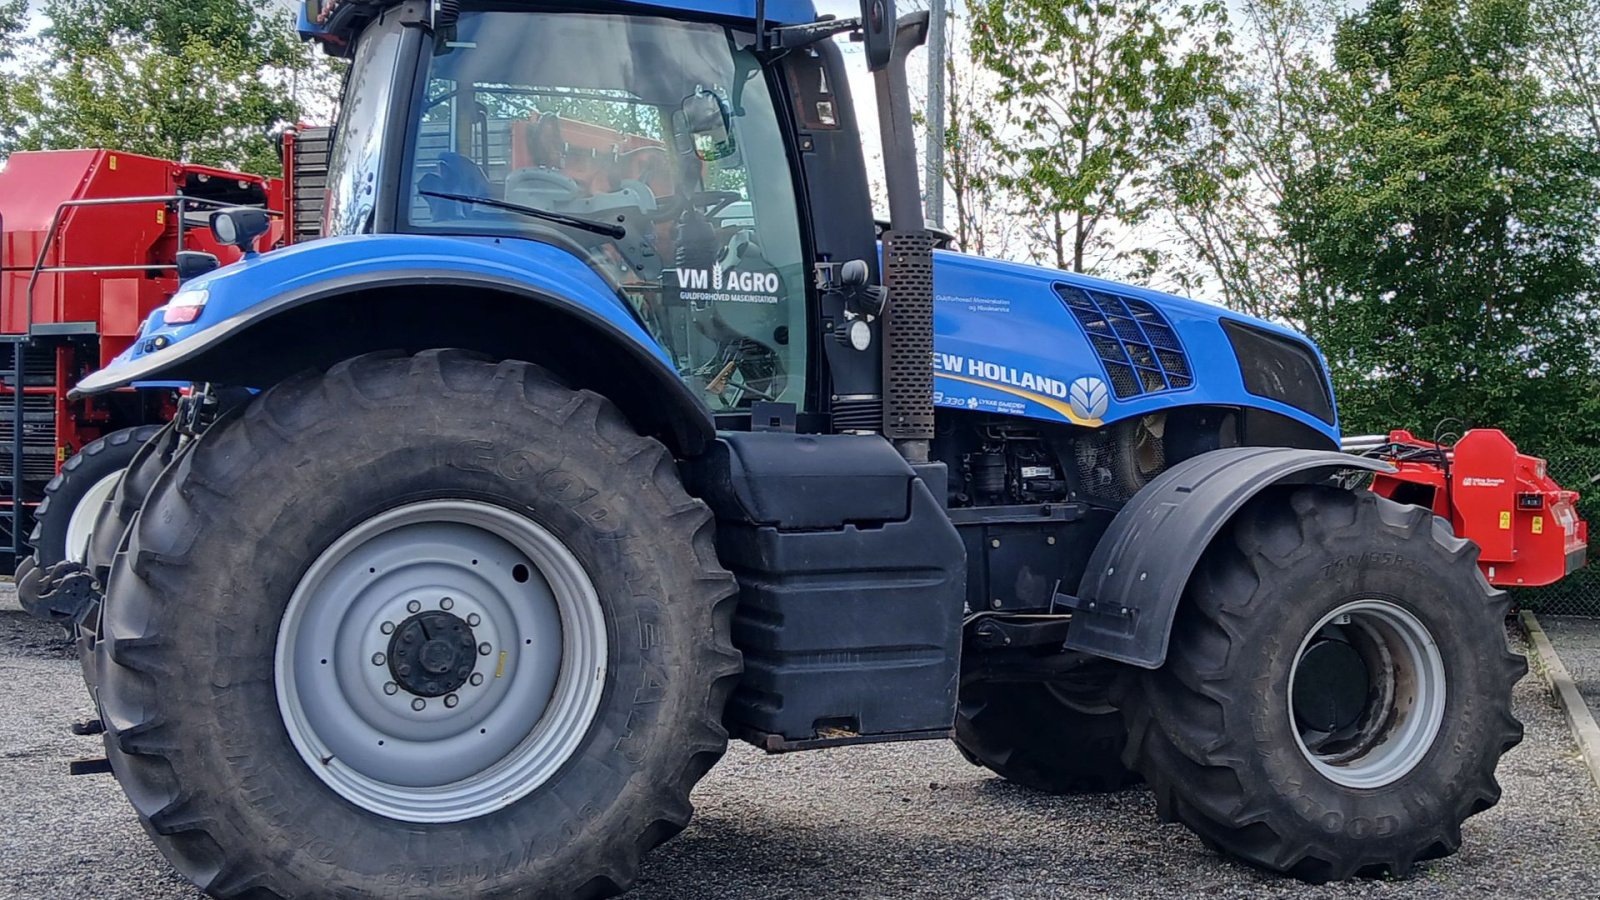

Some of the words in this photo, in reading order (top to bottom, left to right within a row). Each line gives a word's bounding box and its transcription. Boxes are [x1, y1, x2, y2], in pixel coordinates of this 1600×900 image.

[677, 268, 708, 289] VM
[727, 271, 779, 293] AGRO
[680, 291, 730, 302] GULDFORHOVED
[731, 294, 778, 304] MASKINSTATION
[932, 352, 963, 373] EW
[968, 358, 1067, 398] HOLLAND
[933, 391, 965, 406] 8.330
